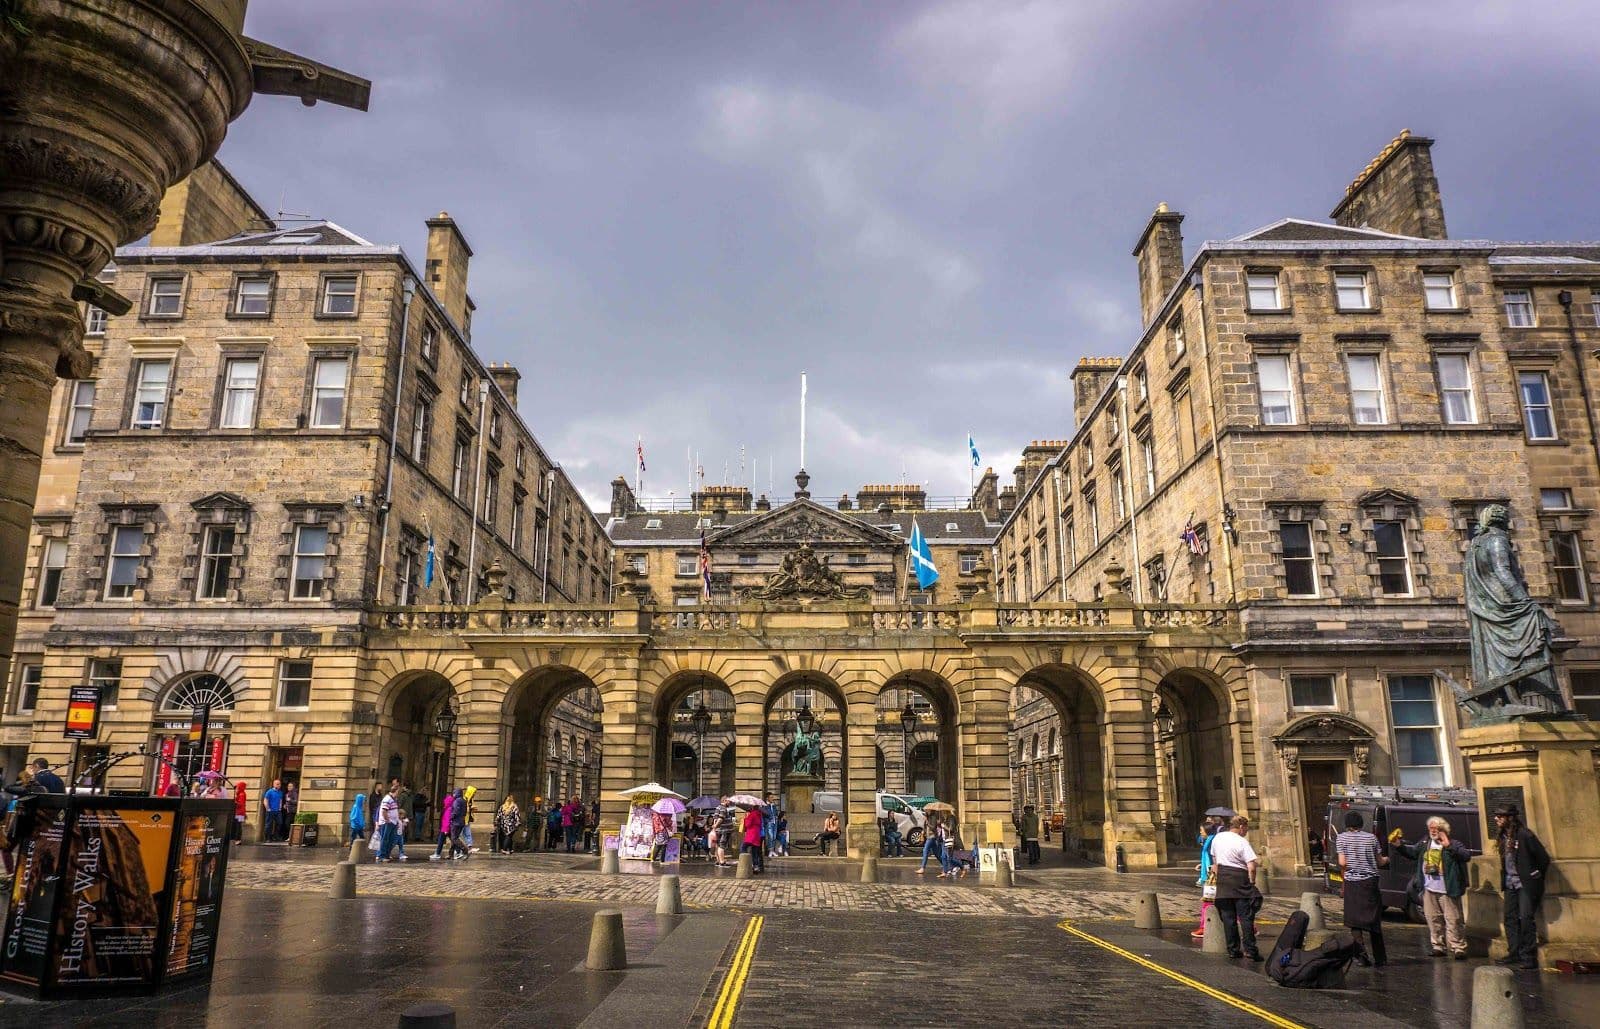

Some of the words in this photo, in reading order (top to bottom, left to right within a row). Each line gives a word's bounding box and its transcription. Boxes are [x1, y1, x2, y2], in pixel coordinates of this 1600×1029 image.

[6, 898, 26, 959] Ghost
[19, 840, 36, 889] Tours
[72, 837, 101, 895] Walks
[59, 898, 97, 974] History
